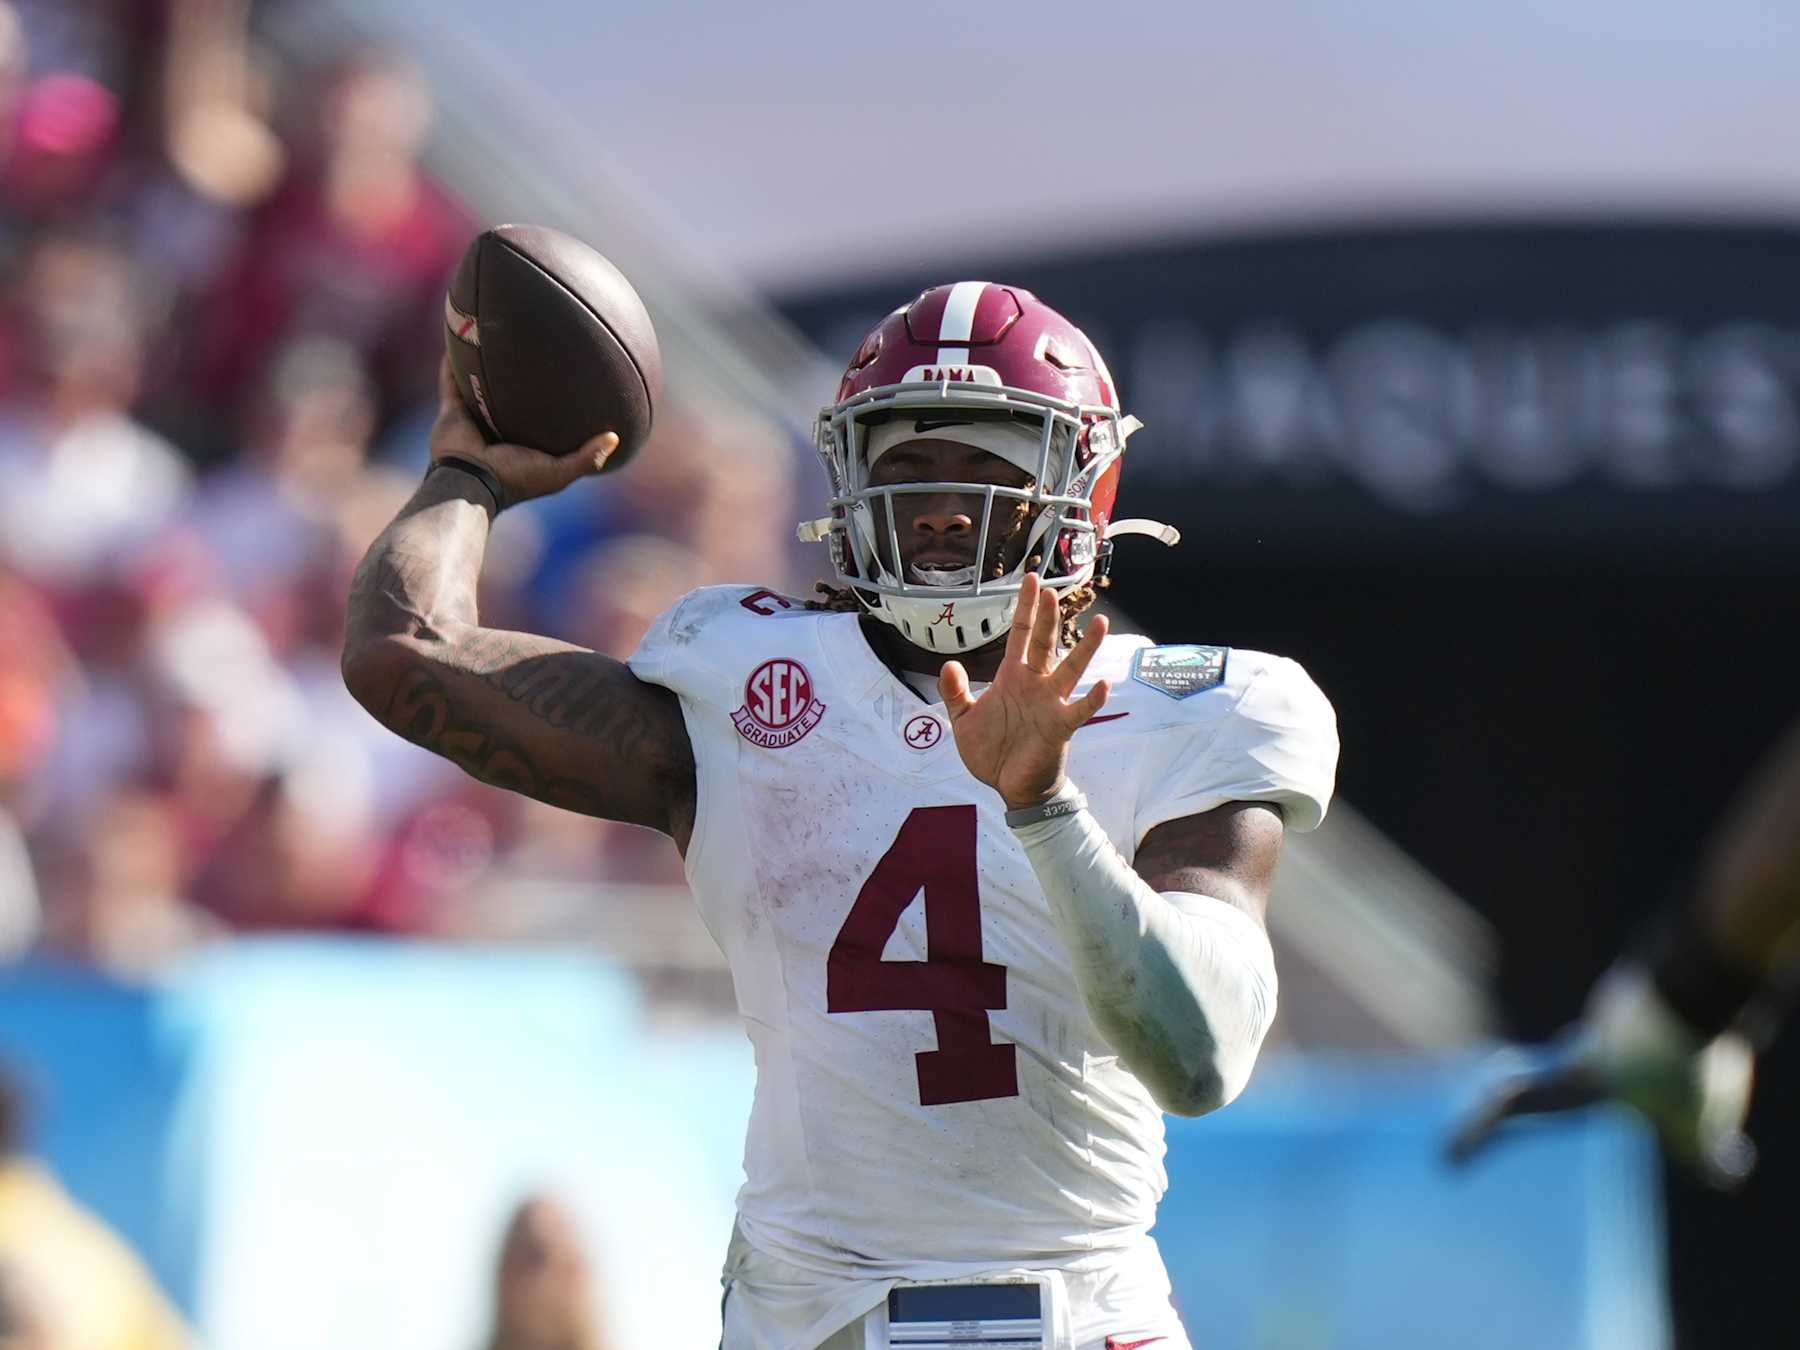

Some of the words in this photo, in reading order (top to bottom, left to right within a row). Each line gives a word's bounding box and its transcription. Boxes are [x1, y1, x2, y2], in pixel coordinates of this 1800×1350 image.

[932, 602, 955, 626] A
[1140, 671, 1211, 680] RELIAQUEST
[750, 664, 806, 725] SEC
[743, 717, 812, 746] GRADUATE
[908, 721, 934, 742] A
[827, 804, 1019, 1106] 4
